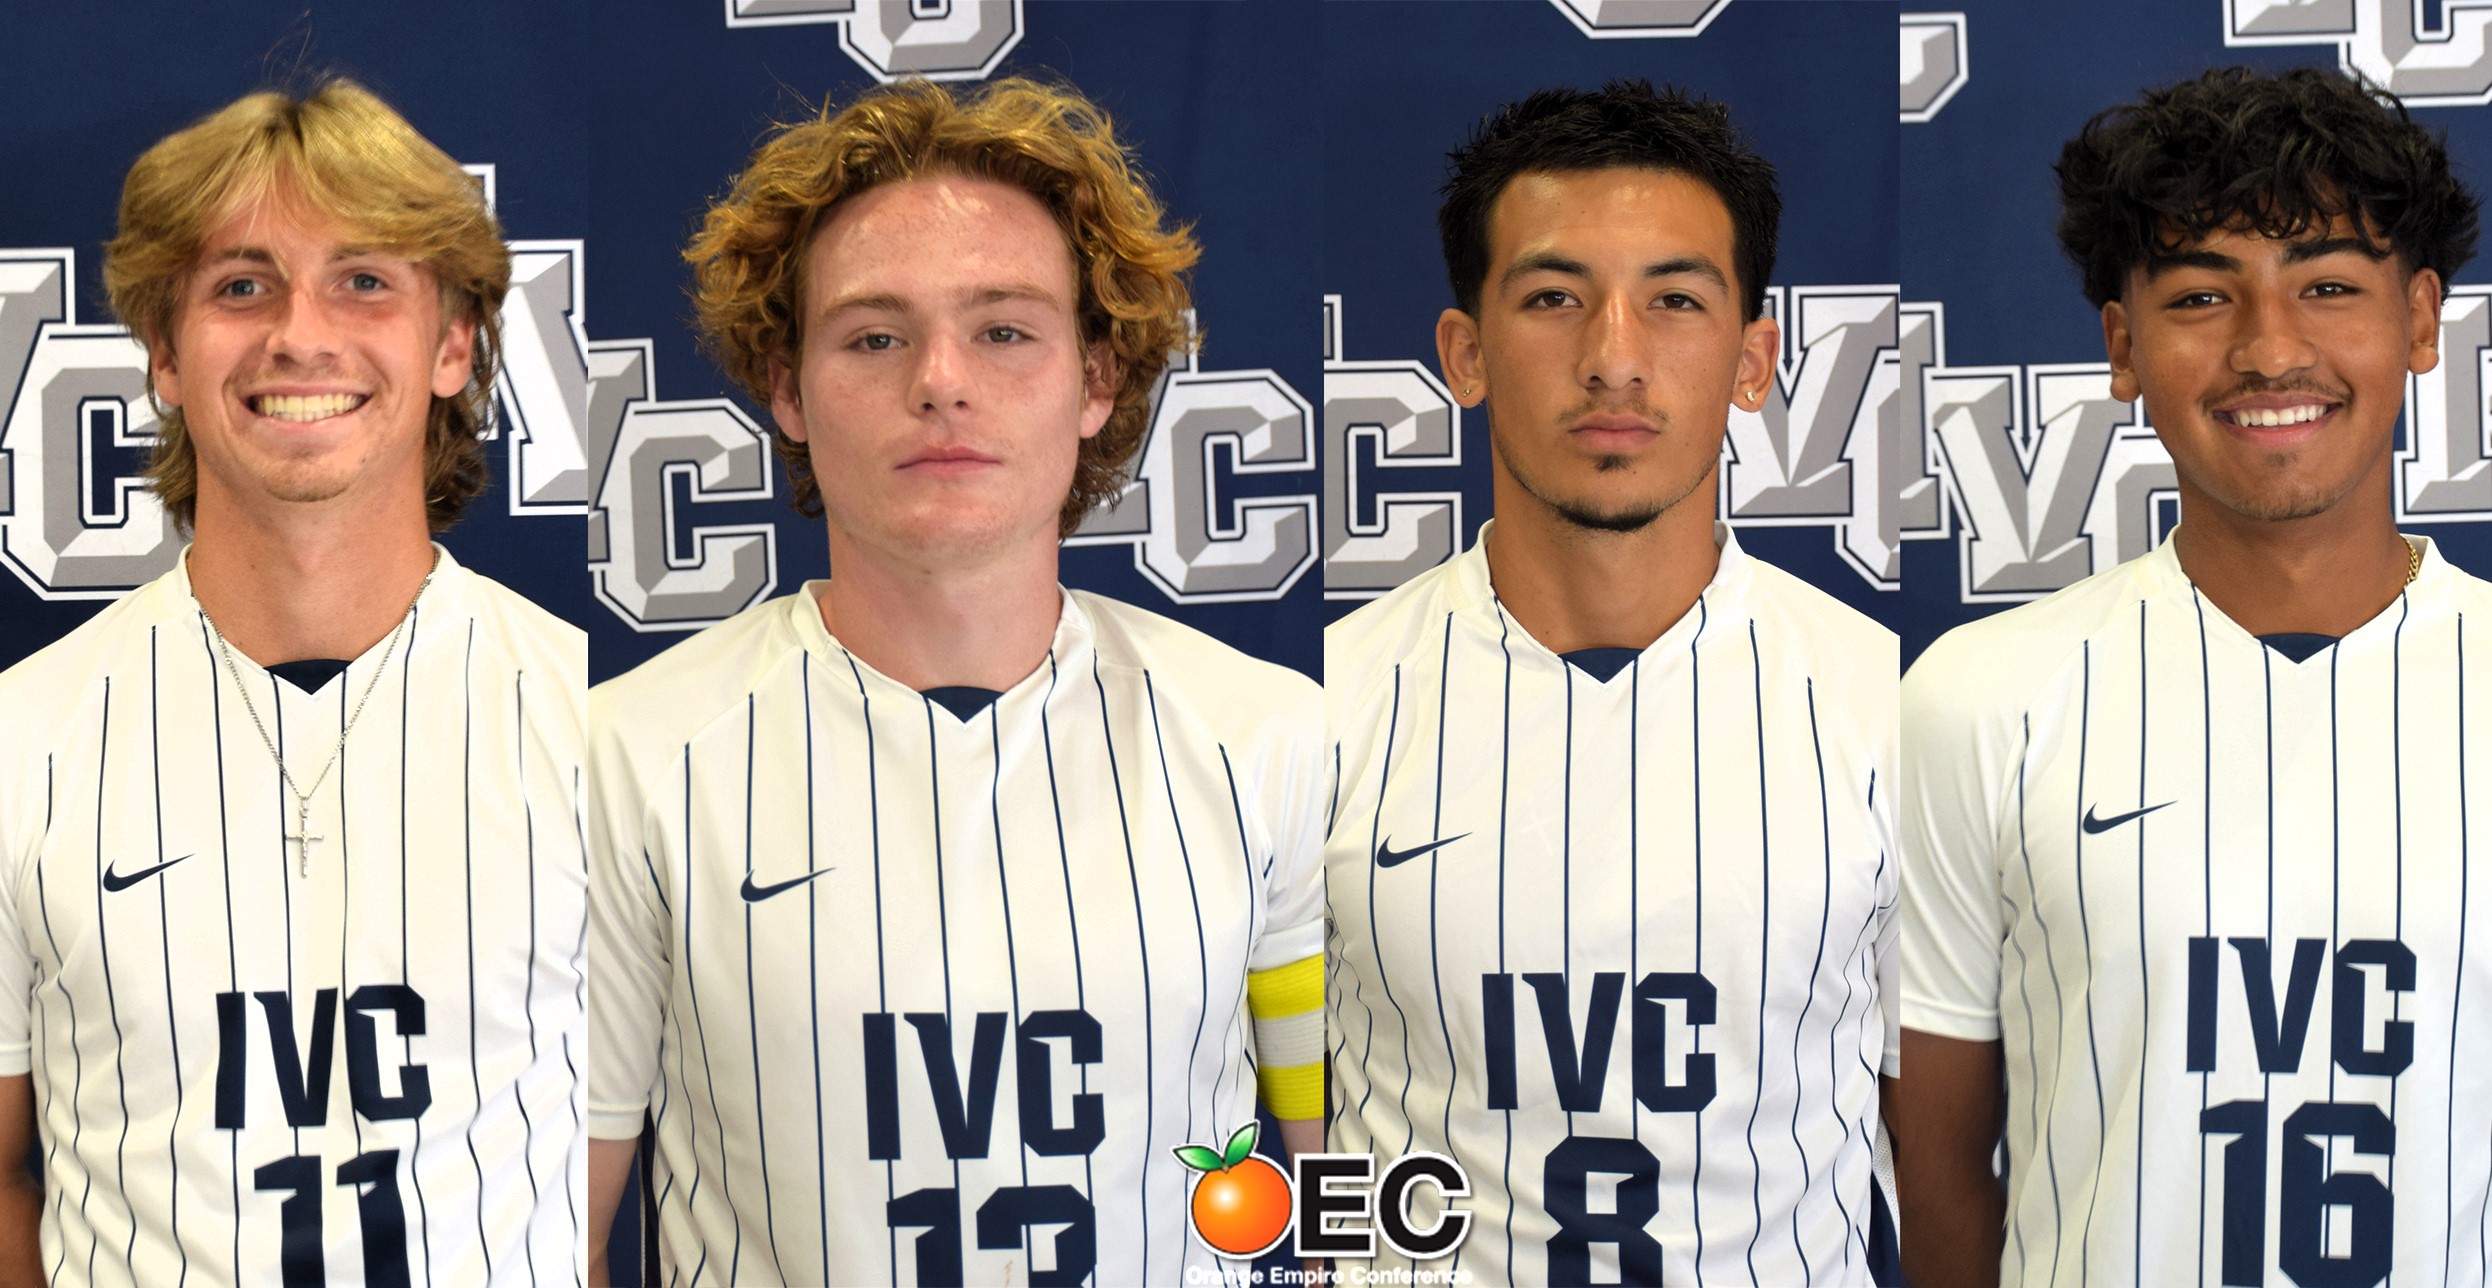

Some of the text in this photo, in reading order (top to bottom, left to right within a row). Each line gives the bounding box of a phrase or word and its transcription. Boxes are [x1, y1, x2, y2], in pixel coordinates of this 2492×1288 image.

[215, 985, 432, 1129] IVC
[1482, 972, 1717, 1113] IVC
[2186, 936, 2417, 1077] IVC
[863, 1009, 1105, 1160] IVC
[254, 1149, 411, 1288] 11
[1544, 1136, 1663, 1288] 8
[2200, 1098, 2396, 1288] 16
